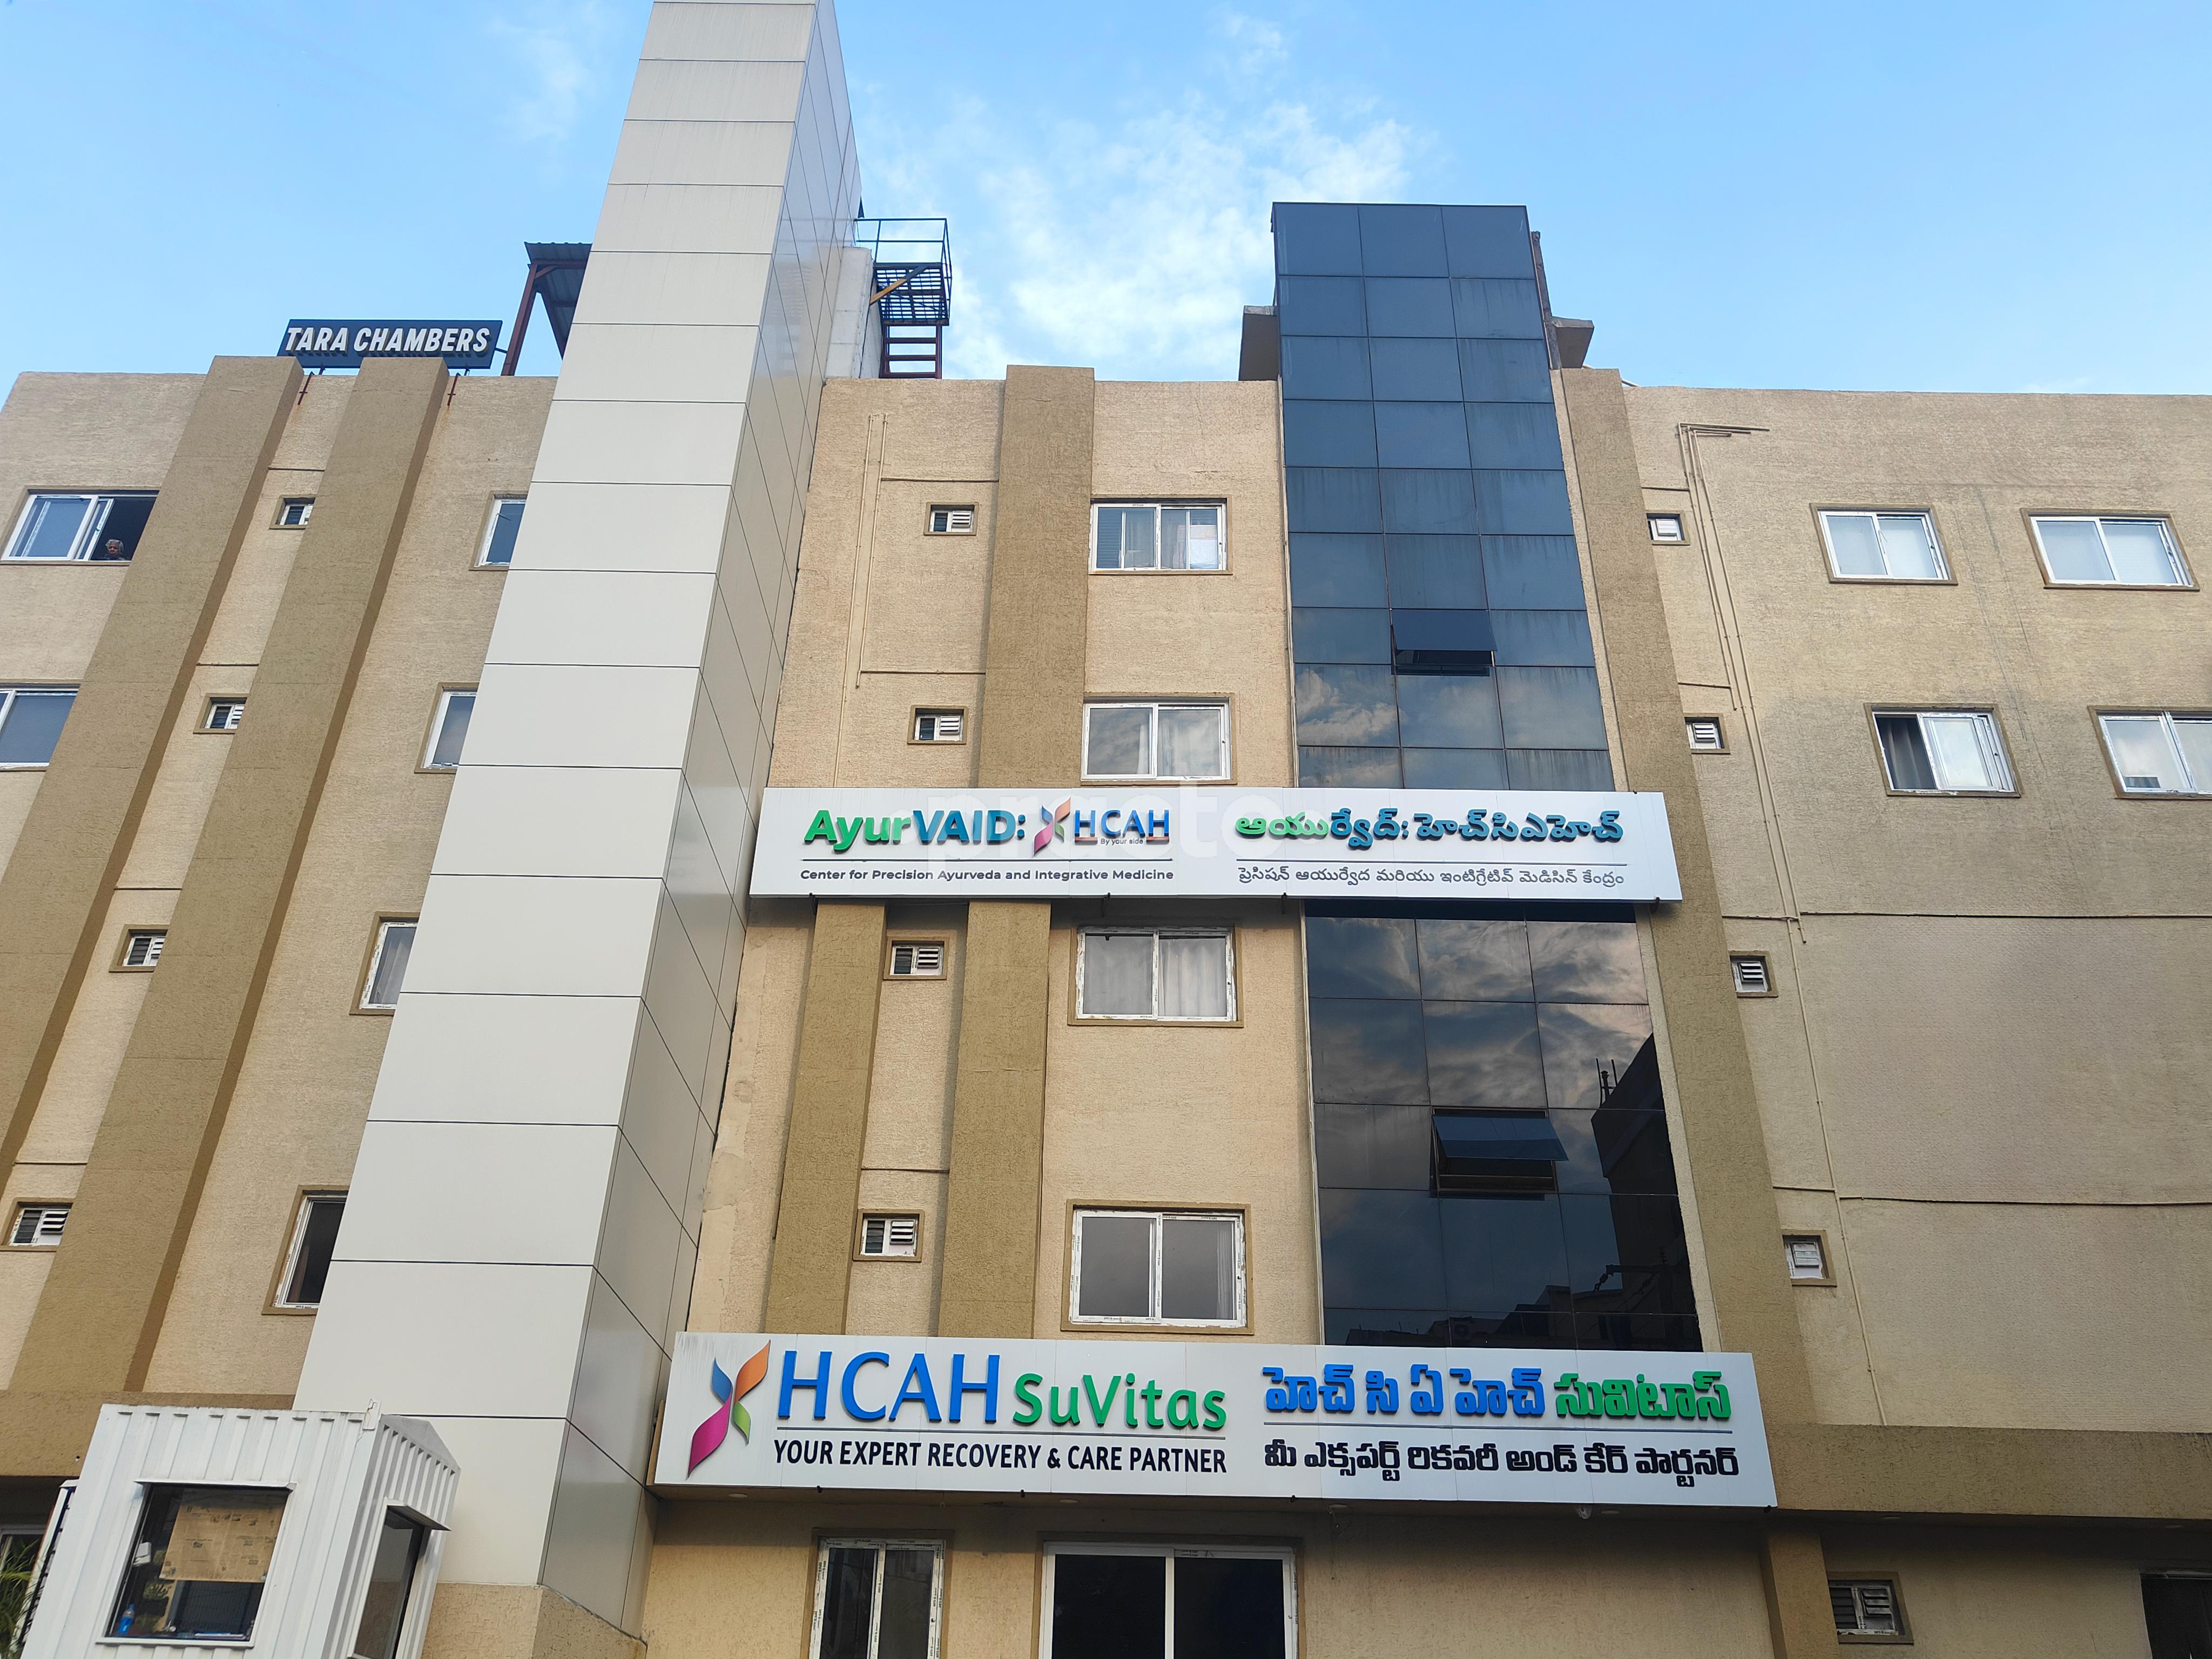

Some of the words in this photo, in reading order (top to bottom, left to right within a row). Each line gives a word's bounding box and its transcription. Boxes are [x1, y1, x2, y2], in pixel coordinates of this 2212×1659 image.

[285, 327, 349, 352] TARA
[353, 328, 490, 353] CHAMBERS
[804, 810, 1026, 852] AyurVAID:
[1074, 810, 1170, 838] HCAH
[800, 869, 845, 880] Center
[849, 869, 868, 880] for
[872, 869, 933, 880] Precision
[938, 870, 1001, 882] Ayurveda
[1005, 870, 1031, 880] and
[1035, 869, 1108, 881] Integrative
[1112, 869, 1174, 879] Medicine
[1296, 867, 1370, 886] ఆయుర్వేద
[1377, 869, 1434, 881] మరియు
[1440, 868, 1514, 886] ఇంటిగ్రేటివ్
[1519, 869, 1577, 883] మెడిసిన్
[1582, 869, 1624, 887] కేంద్రం
[778, 1350, 1000, 1423] HCAH
[1013, 1373, 1226, 1429] SuVitas
[1262, 1364, 1355, 1413] హెచ్
[1365, 1370, 1399, 1414] సి
[1449, 1367, 1546, 1415] హెచ్
[774, 1439, 833, 1465] YOUR
[839, 1441, 922, 1466] EXPERT
[927, 1443, 1042, 1469] RECOVERY
[1047, 1448, 1061, 1469] &
[1068, 1446, 1122, 1471] CARE
[1130, 1447, 1227, 1473] PARTNER
[1264, 1439, 1297, 1467] మీ
[1407, 1443, 1499, 1471] రికవరీ
[1506, 1444, 1577, 1472] అండ్
[1583, 1442, 1628, 1473] కేర్
[1634, 1447, 1739, 1487] పార్టనర్
